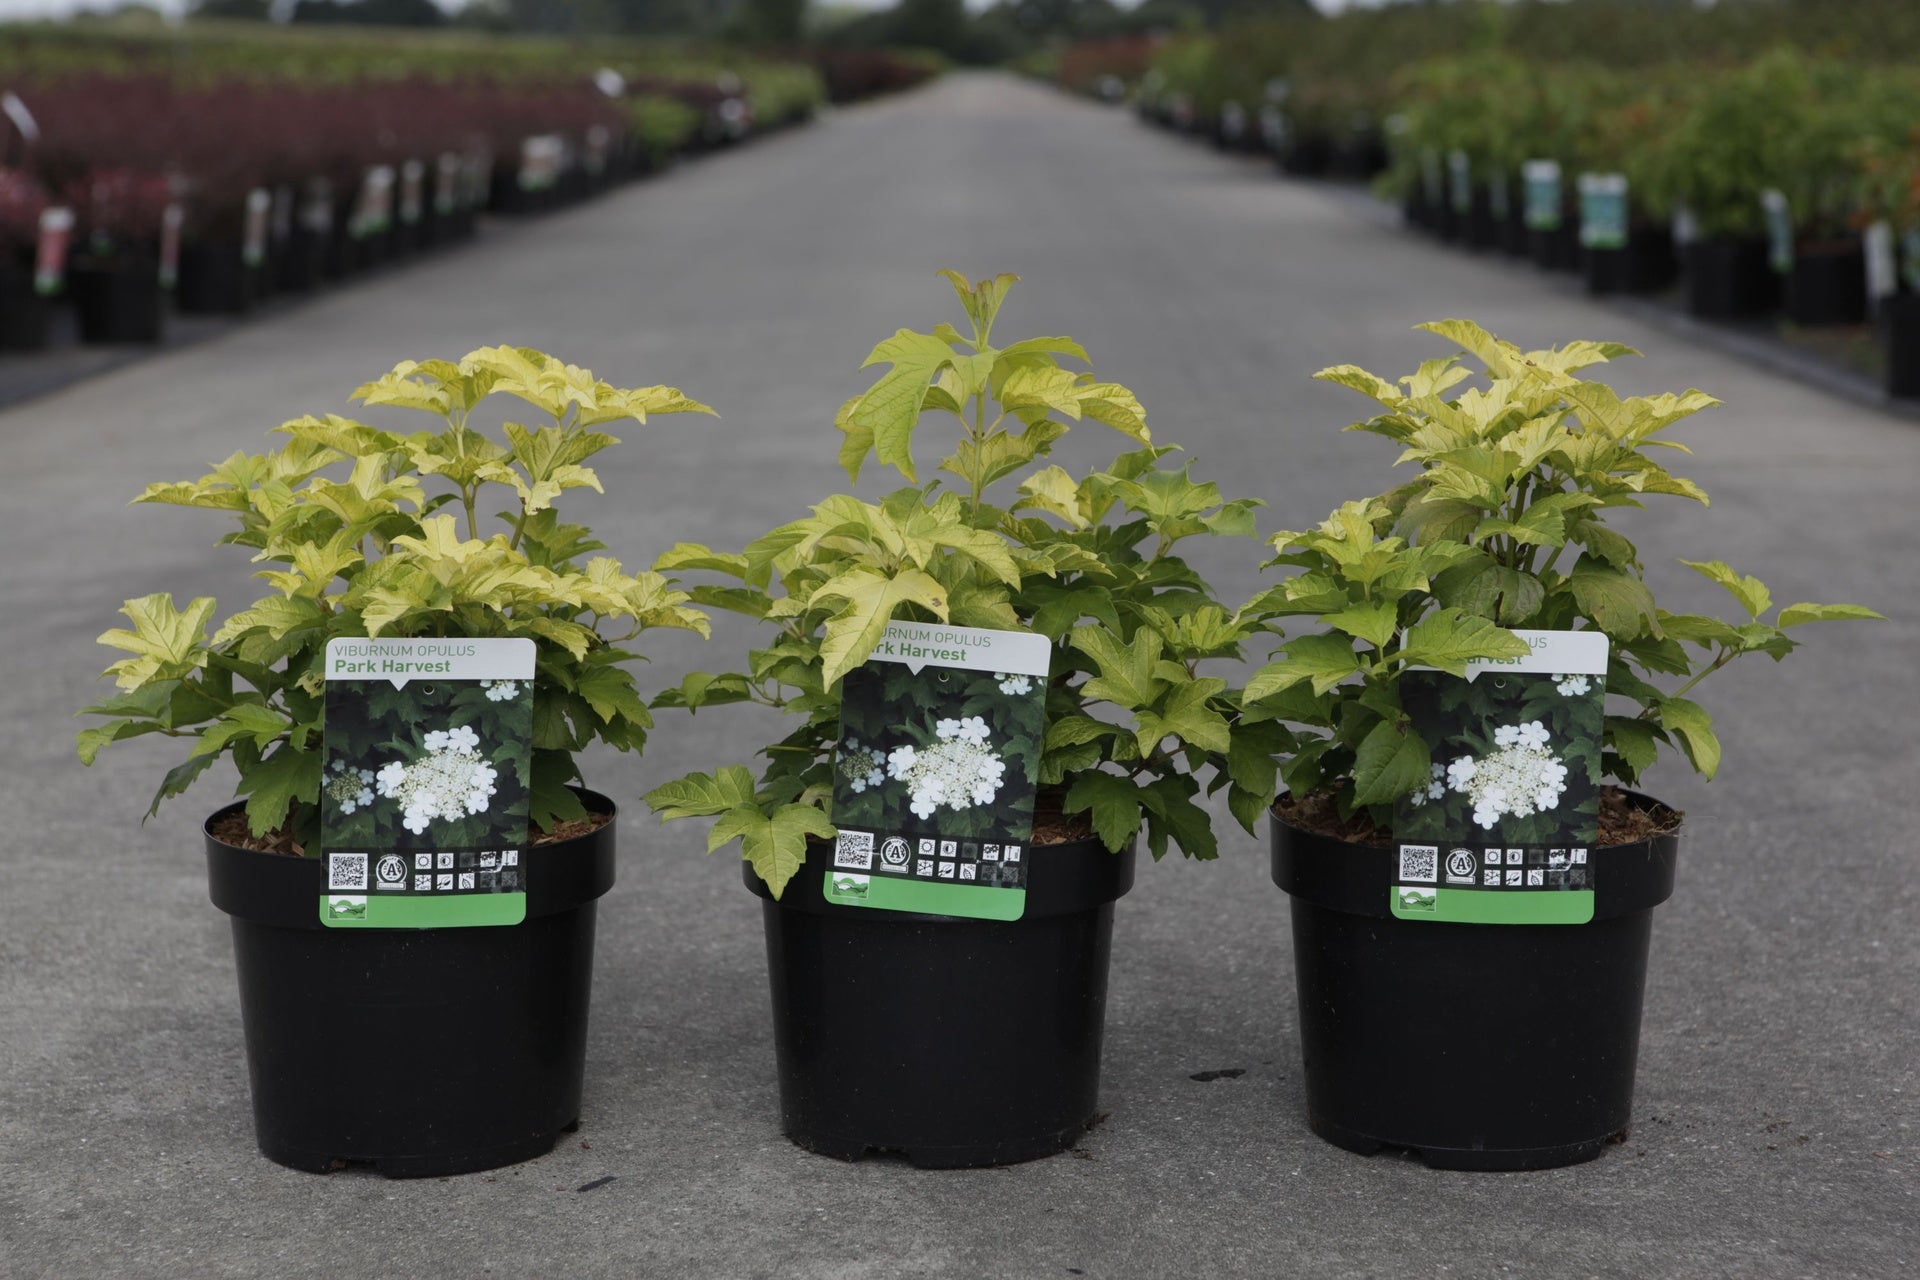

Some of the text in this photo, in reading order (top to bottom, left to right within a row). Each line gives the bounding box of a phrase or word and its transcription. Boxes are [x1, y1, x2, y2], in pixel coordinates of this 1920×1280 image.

[934, 632, 991, 648] OPULUS
[334, 645, 476, 657] VIBURNUM OPULUS
[899, 642, 967, 662] Harvest
[335, 659, 451, 673] Park Harvest
